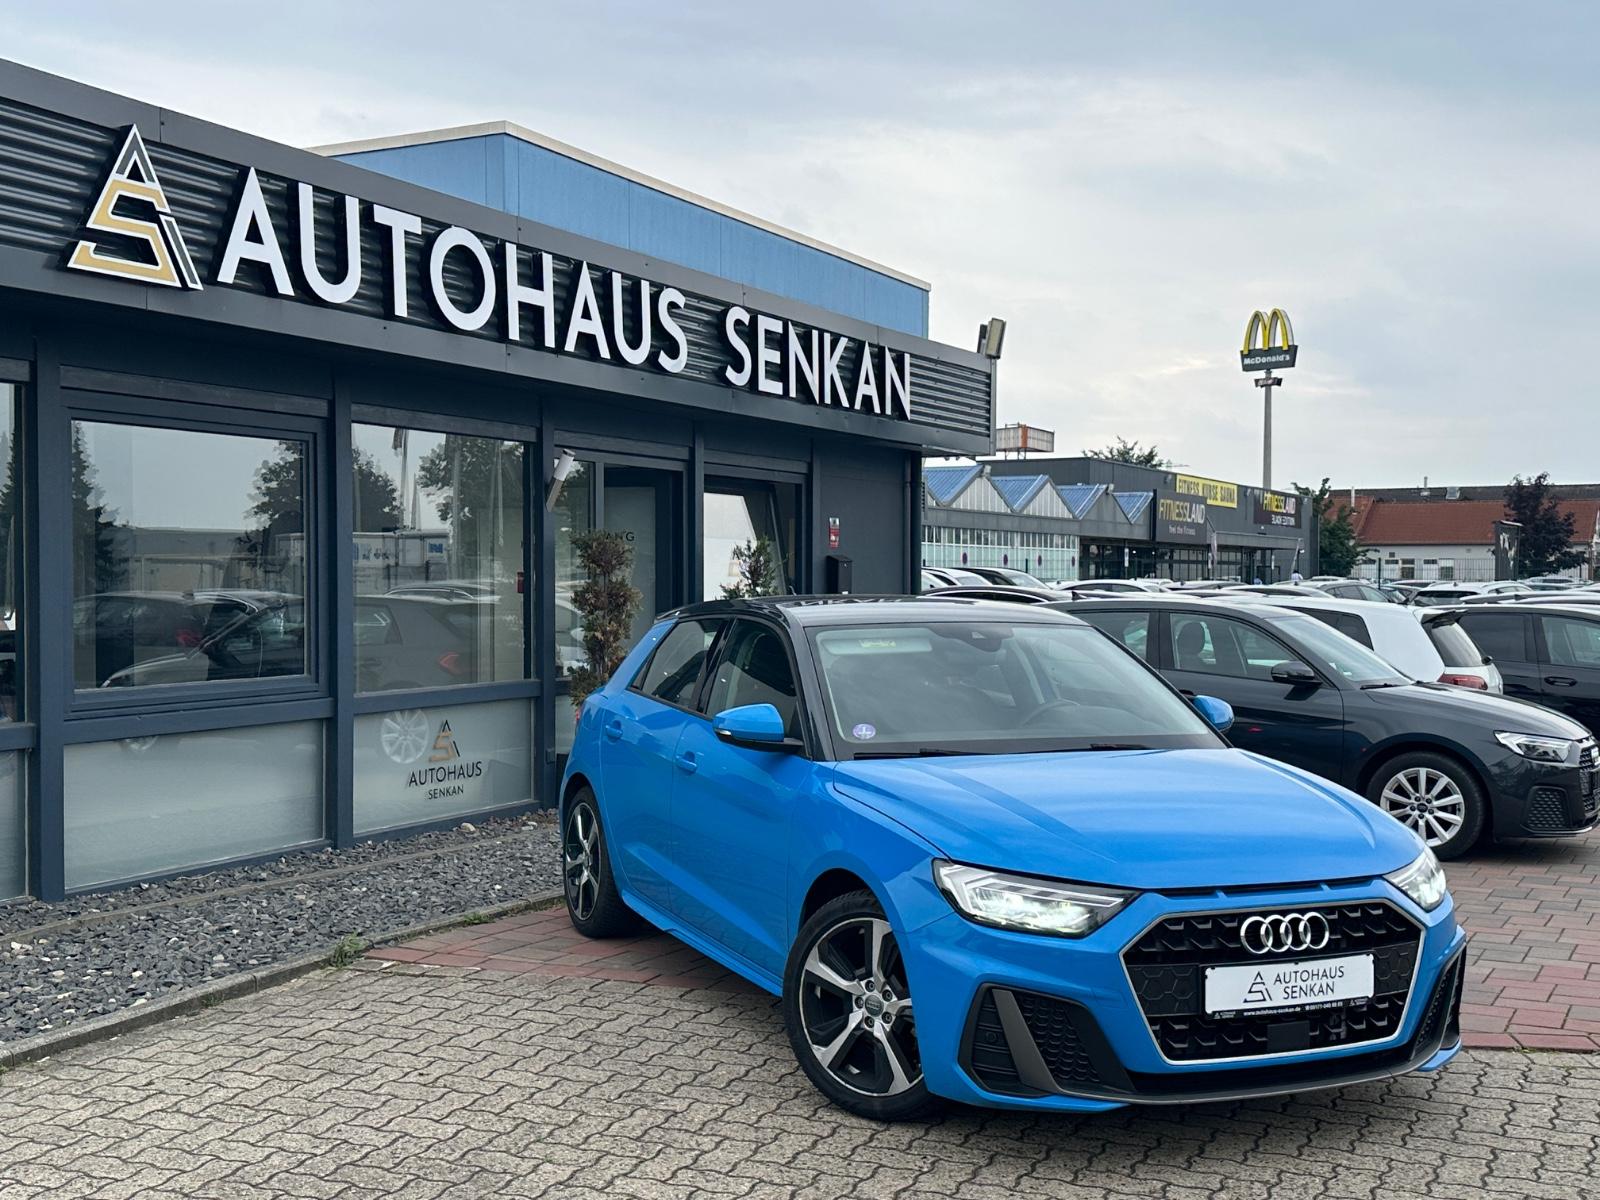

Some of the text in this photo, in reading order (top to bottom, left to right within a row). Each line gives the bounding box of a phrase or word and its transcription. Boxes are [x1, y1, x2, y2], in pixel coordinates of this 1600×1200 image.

[217, 166, 910, 421] AUTOHAUS SENKAN
[1243, 354, 1290, 365] McDonald's
[1179, 479, 1199, 496] FITNESS
[1159, 499, 1205, 524] FITNESSLAND
[1263, 491, 1295, 514] FITNESSLAND
[408, 761, 482, 787] AUTOHAUS
[428, 785, 464, 800] SENKAN
[1274, 966, 1345, 985] AUTOHAUS
[1283, 981, 1335, 1000] SENKAN
